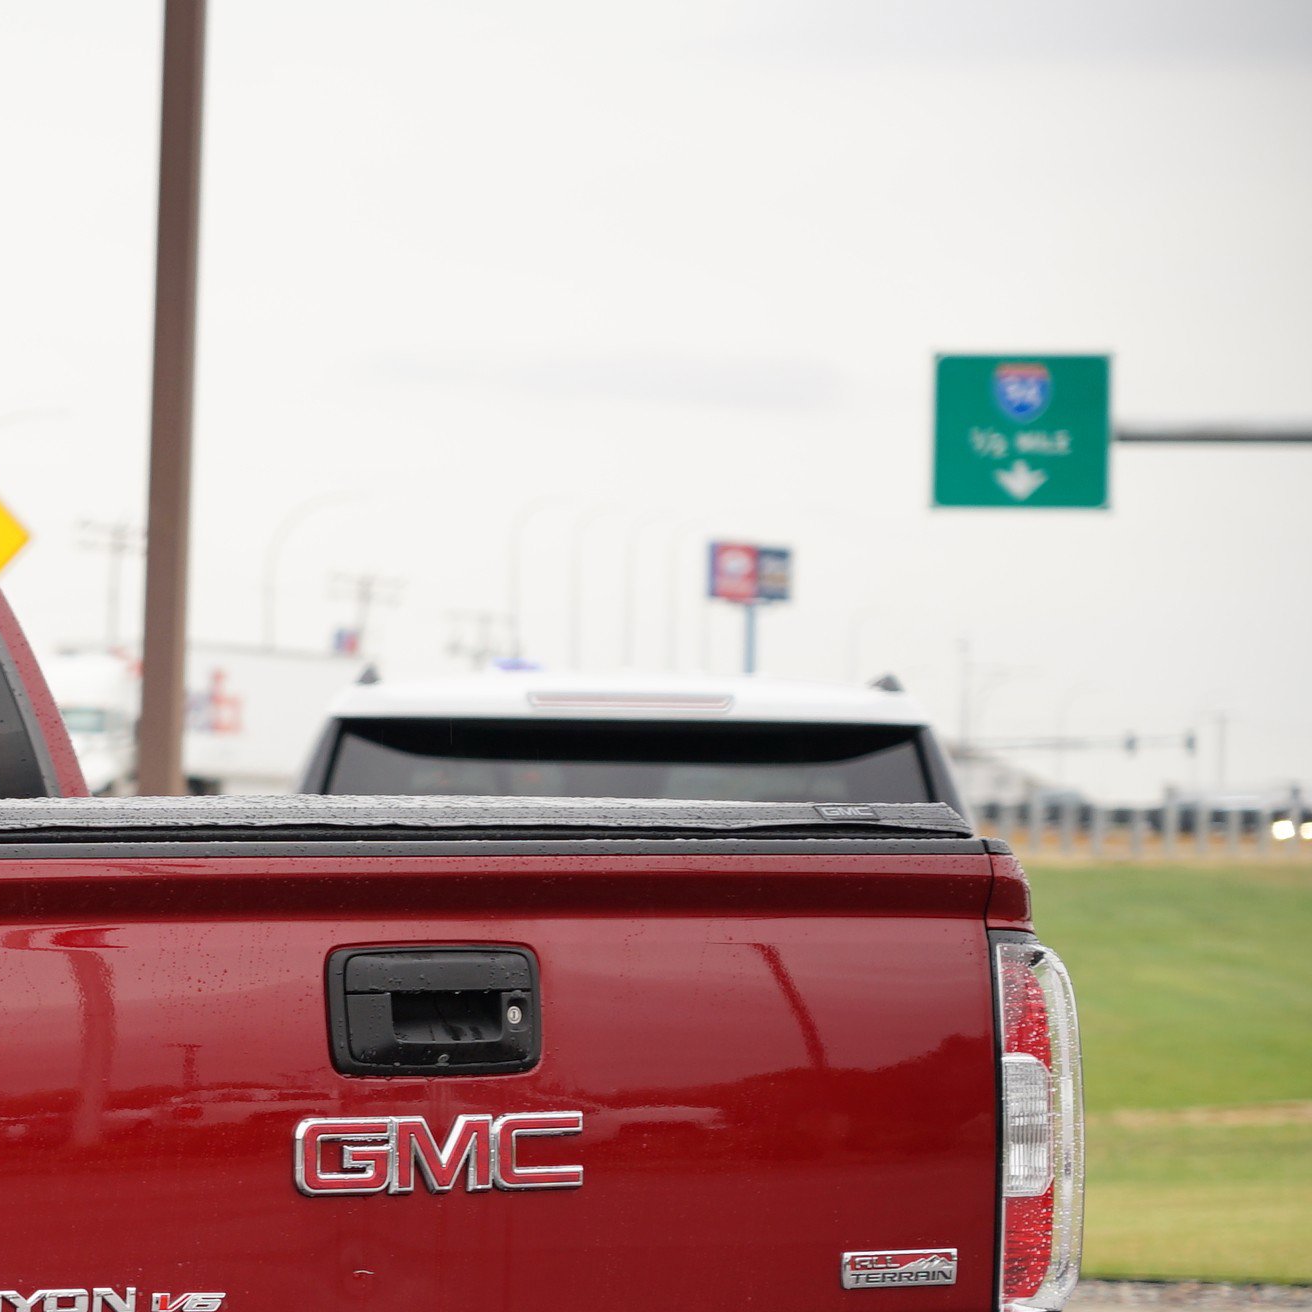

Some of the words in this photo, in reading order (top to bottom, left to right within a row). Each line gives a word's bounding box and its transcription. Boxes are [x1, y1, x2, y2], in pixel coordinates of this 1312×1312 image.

[822, 807, 874, 816] GMC
[294, 1111, 583, 1196] GMC
[854, 1256, 901, 1269] ALL
[851, 1270, 953, 1285] TERRAIN
[151, 1291, 227, 1312] V6
